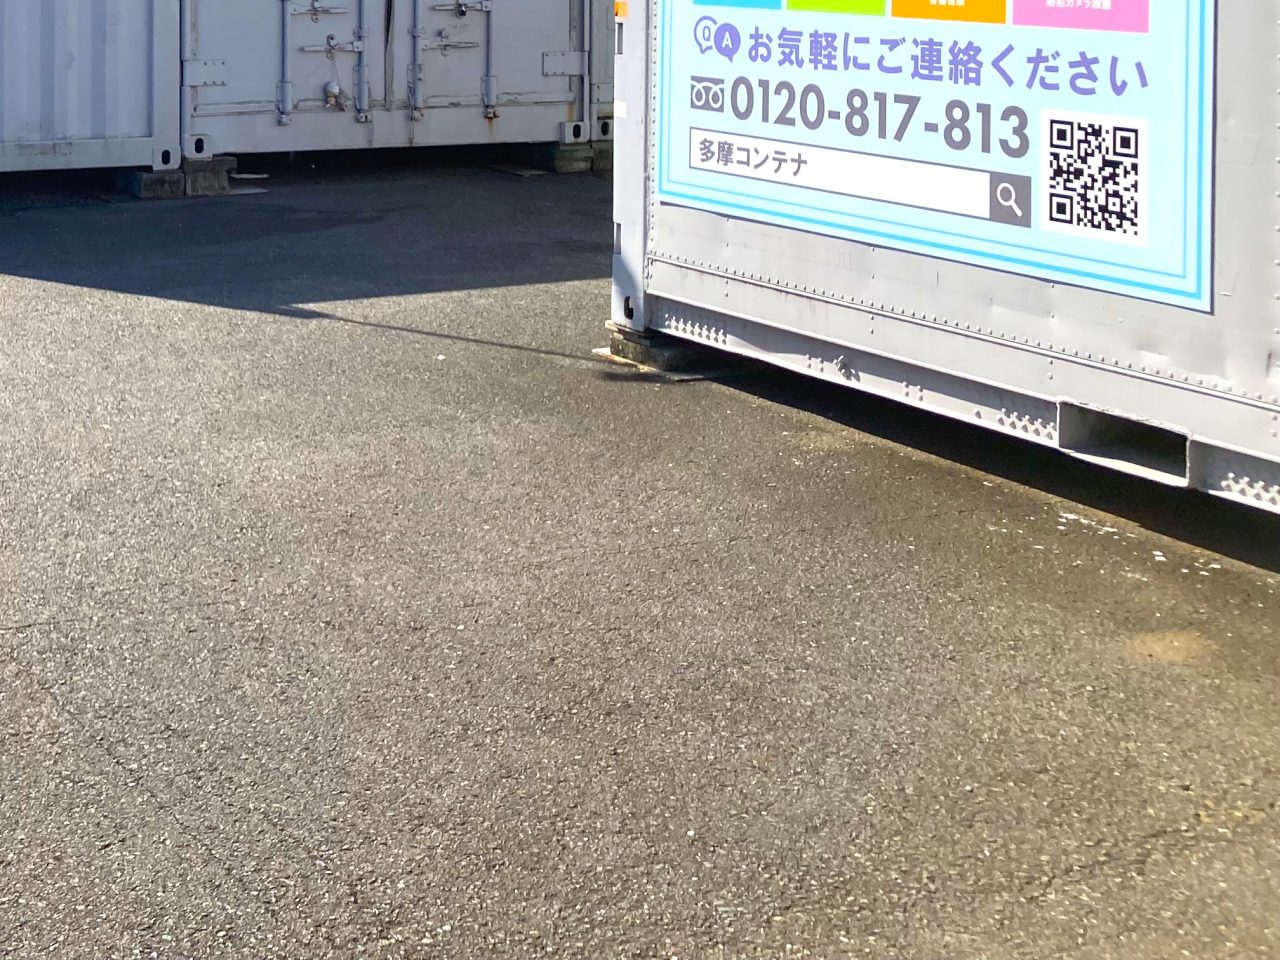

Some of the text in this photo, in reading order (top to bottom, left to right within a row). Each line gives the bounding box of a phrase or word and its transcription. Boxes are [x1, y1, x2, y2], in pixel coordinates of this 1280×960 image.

[748, 25, 1149, 97] お気軽にご連絡ください
[730, 75, 1031, 159] 0120-817-813
[699, 137, 808, 177] 多摩コンテナ
